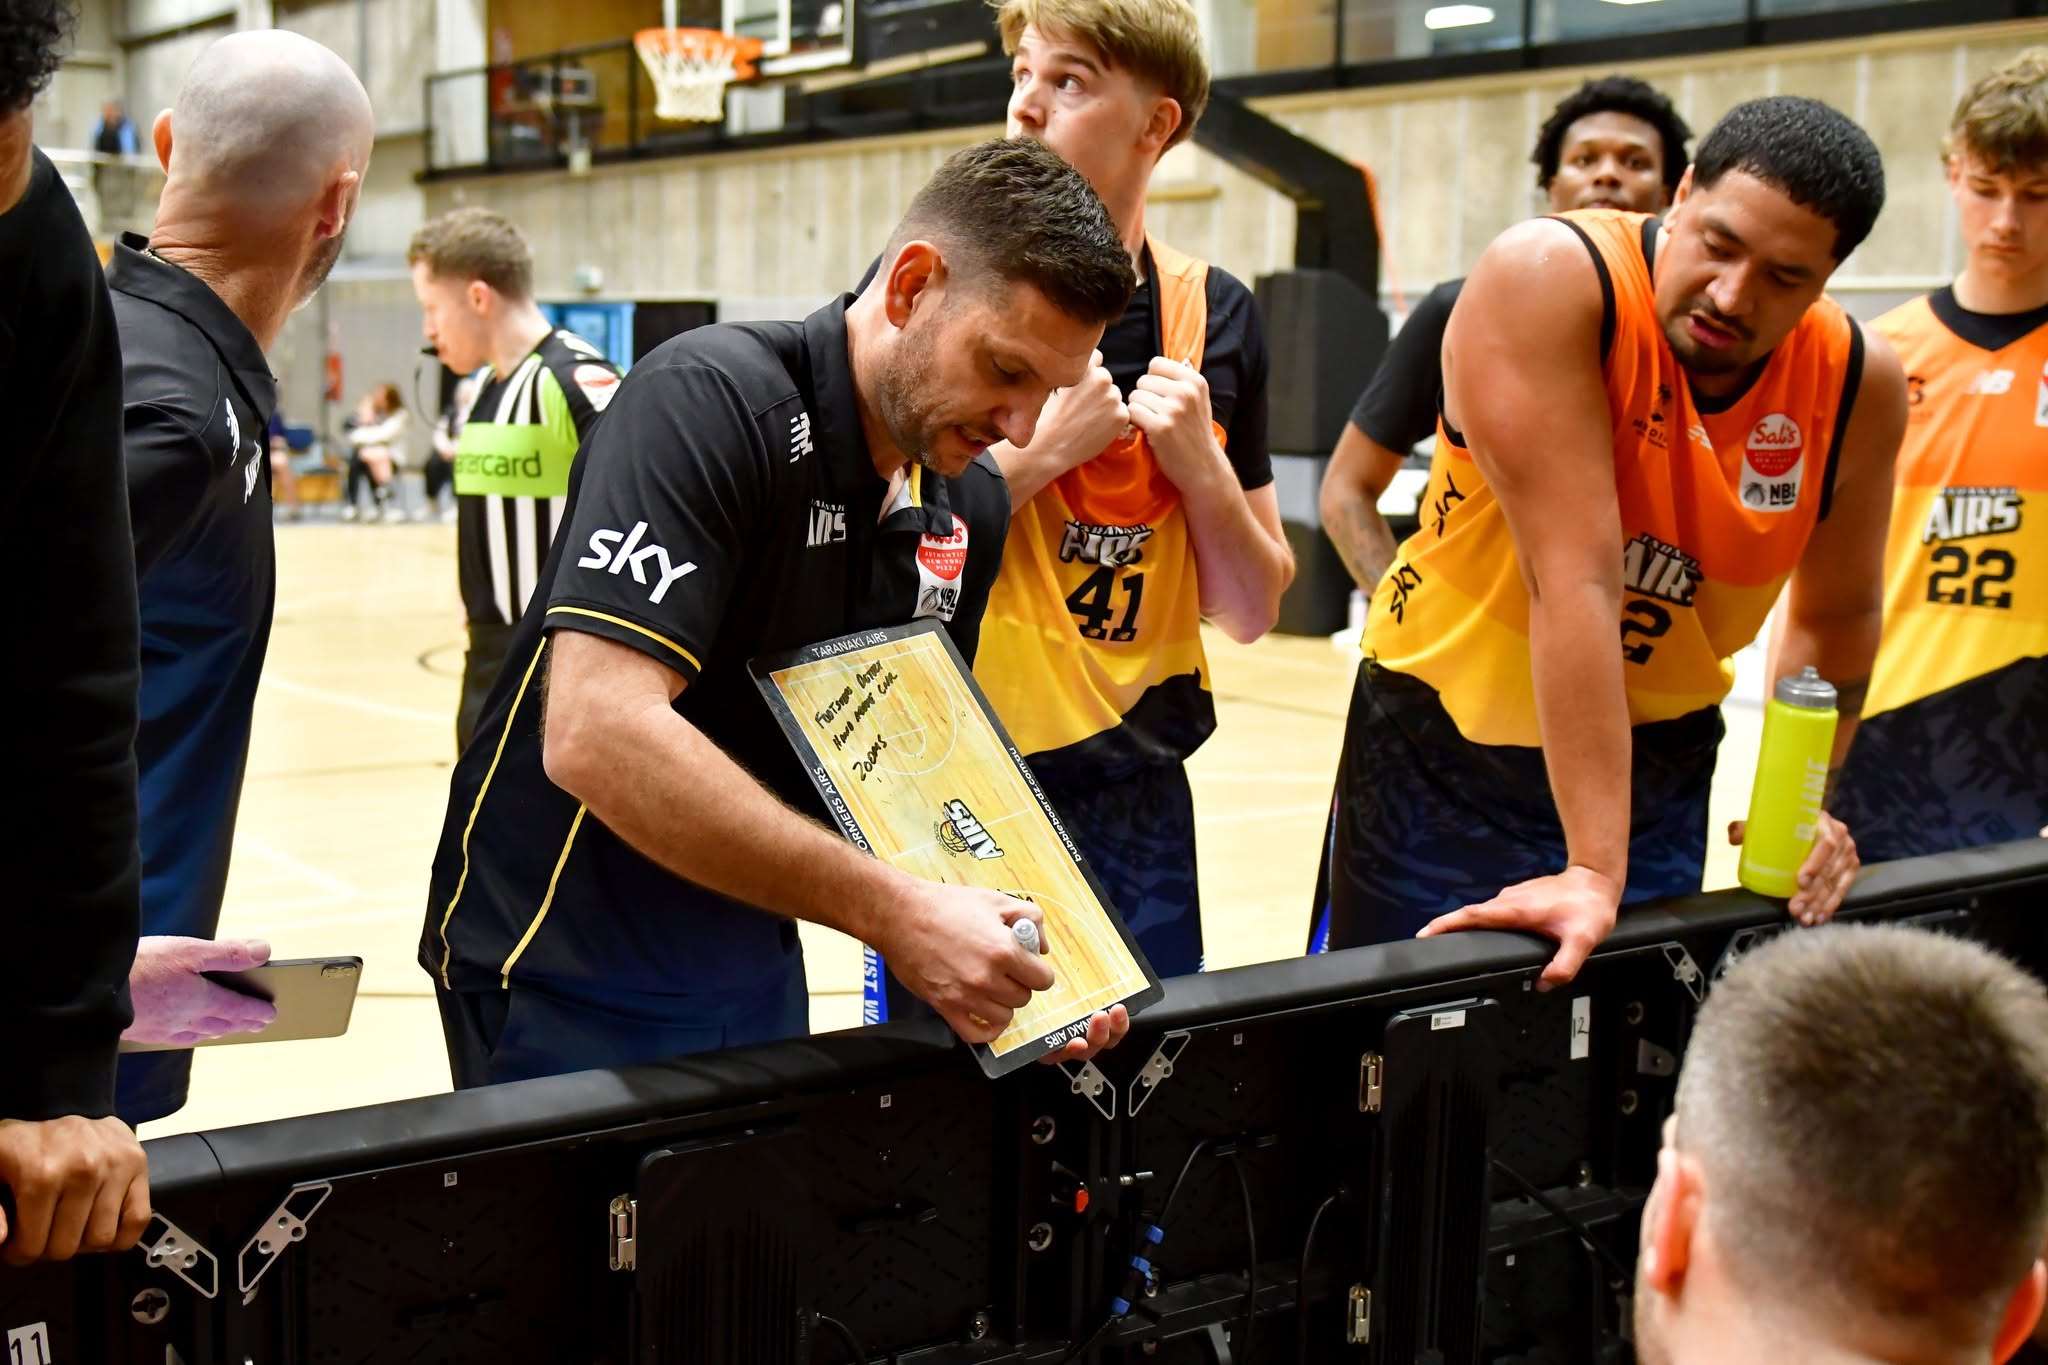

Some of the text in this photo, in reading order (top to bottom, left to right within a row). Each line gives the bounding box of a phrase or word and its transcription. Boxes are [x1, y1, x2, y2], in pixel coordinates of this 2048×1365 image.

[1754, 422, 1798, 445] Sal's
[1923, 494, 2025, 544] AIRS
[577, 520, 699, 606] sky
[1926, 546, 2016, 609] 22
[1064, 565, 1145, 641] 41
[812, 631, 888, 658] TARANAKI AIRS
[813, 766, 869, 853] ORMERS AIRS
[943, 798, 1005, 861] AIRS
[1008, 746, 1082, 863] bubbleboardz.com.au
[1044, 1032, 1067, 1049] AIRS
[1572, 1016, 1590, 1040] 12
[10, 1330, 45, 1365] 11
